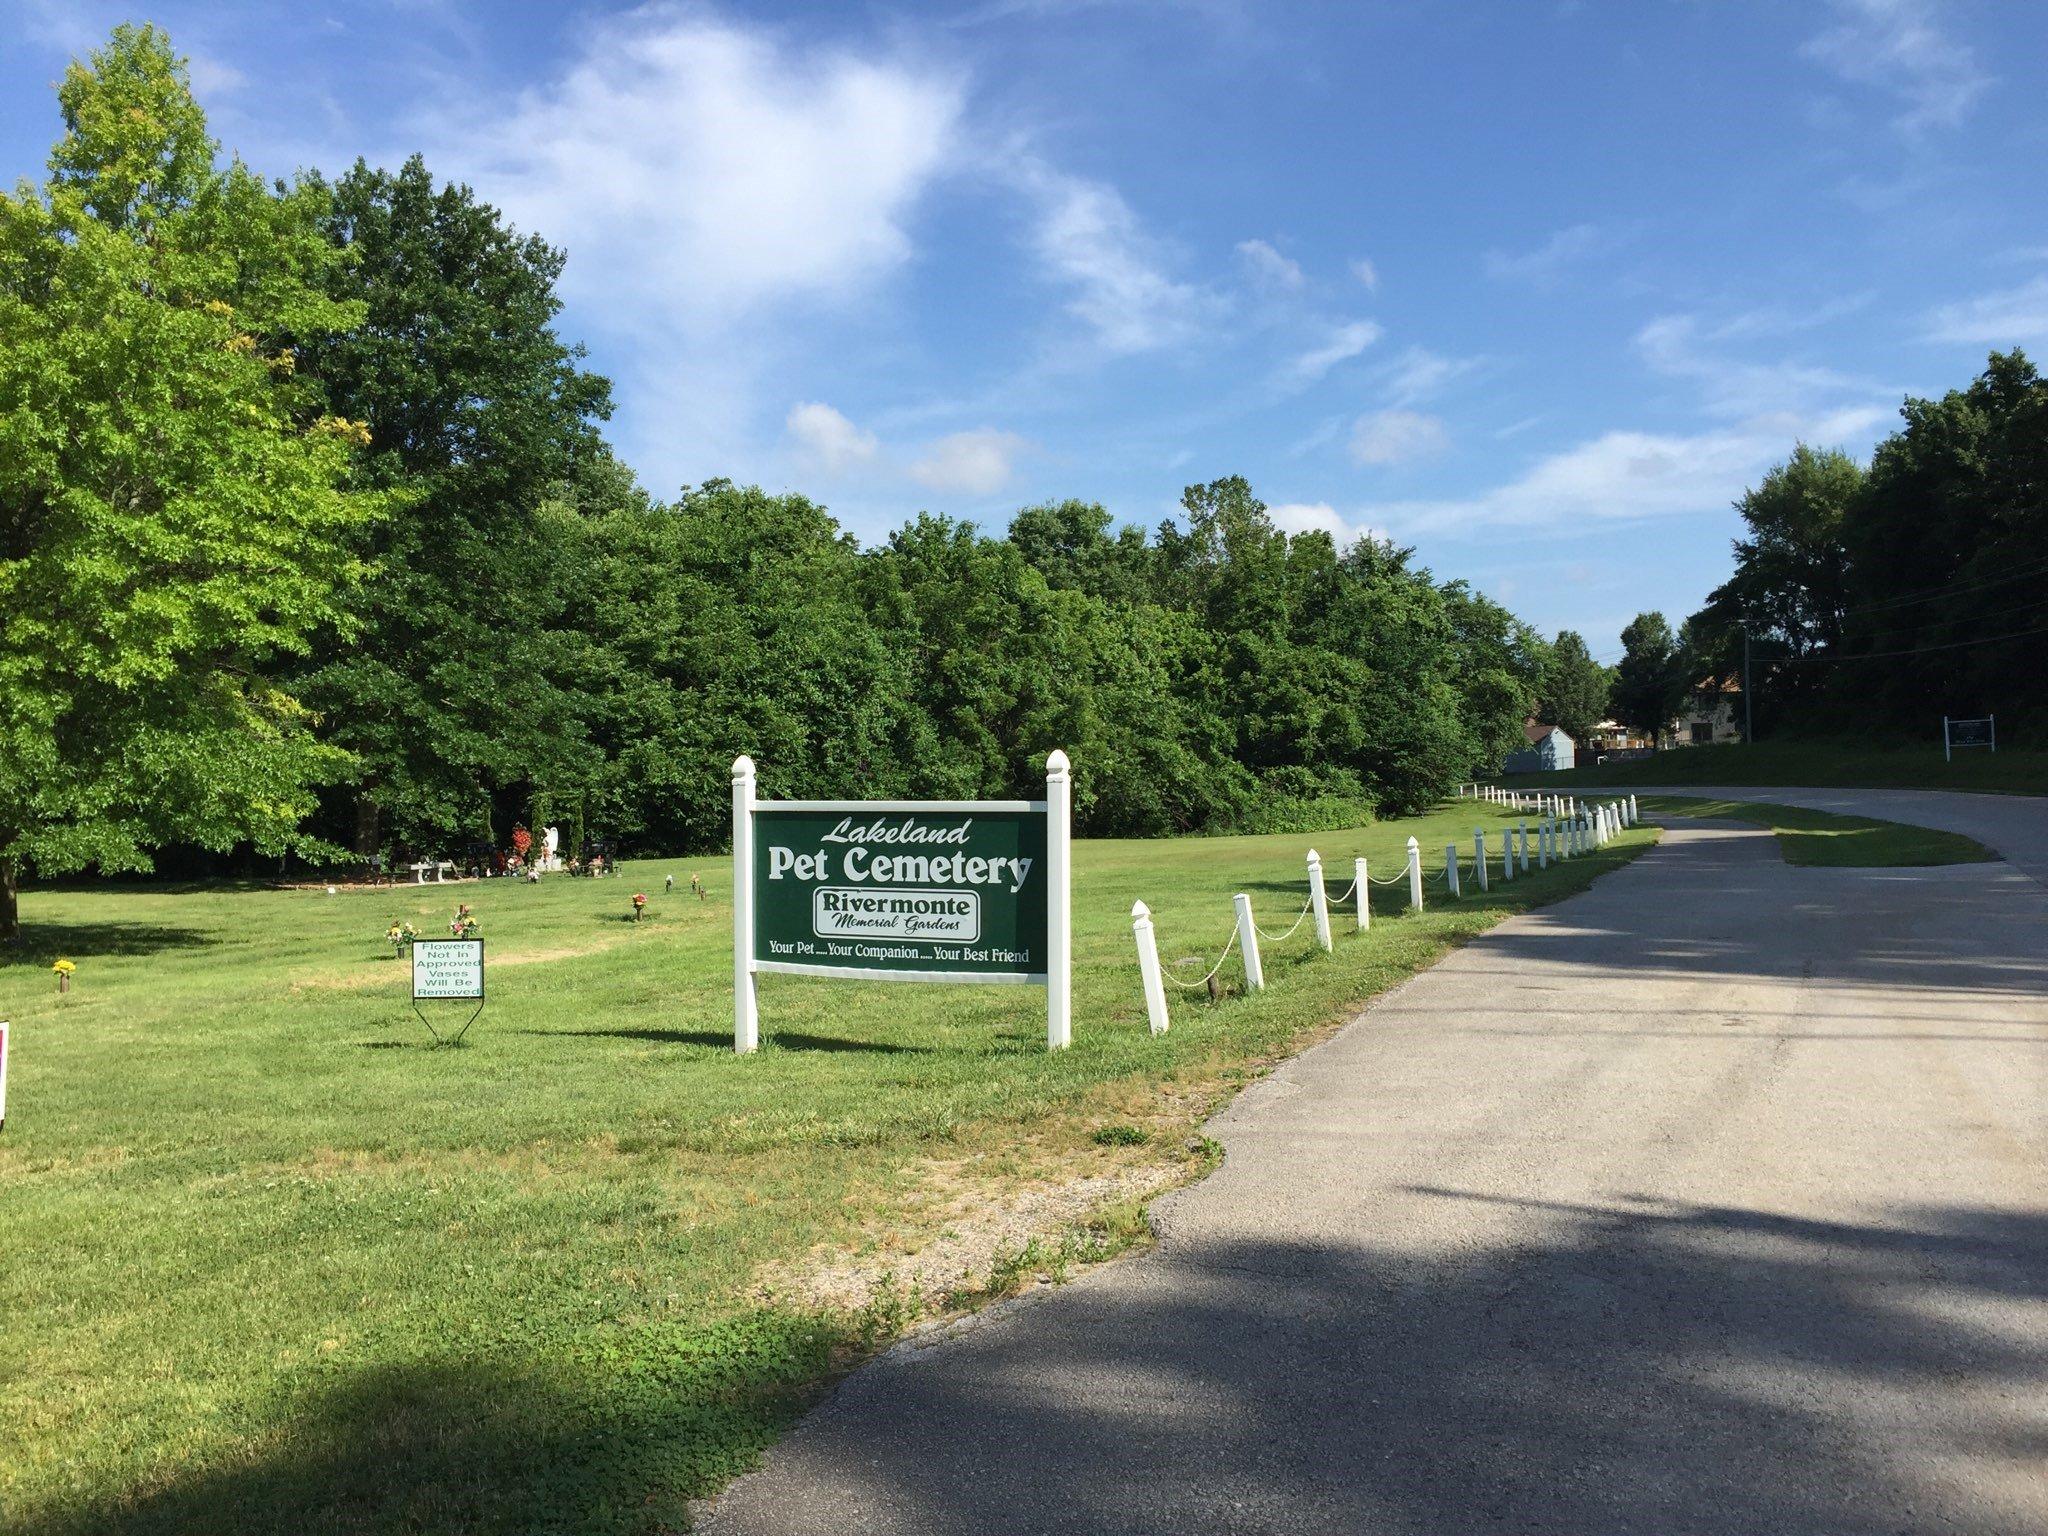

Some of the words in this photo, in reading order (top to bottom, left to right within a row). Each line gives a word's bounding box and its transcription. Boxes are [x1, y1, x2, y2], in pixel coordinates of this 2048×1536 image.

[820, 816, 973, 845] Lakeland
[768, 846, 829, 880] Pet
[843, 846, 1034, 893] Cemetery
[822, 893, 970, 916] Rivermonte
[831, 912, 899, 929] Memorial
[904, 916, 960, 935] Gardens
[769, 940, 794, 954] Your
[933, 946, 961, 960] Your
[963, 947, 989, 962] Best
[991, 948, 1030, 963] Friend
[416, 960, 481, 969] Approved
[429, 970, 469, 978] Vases
[417, 988, 480, 996] Removed
